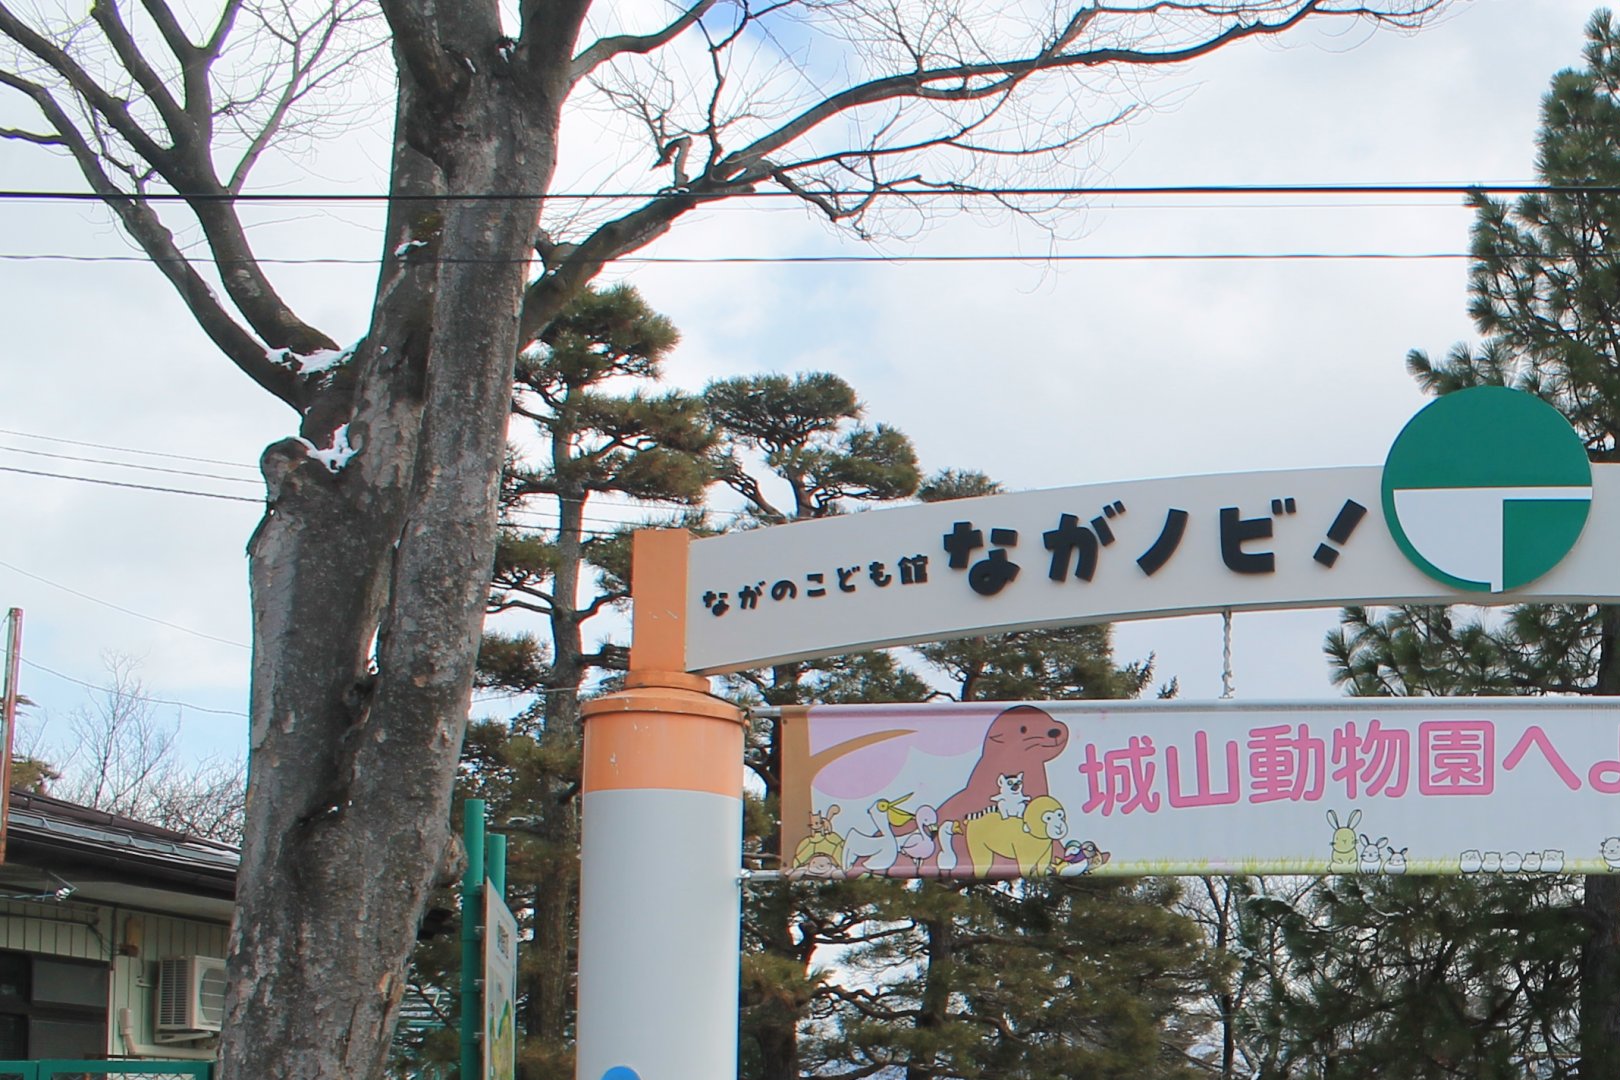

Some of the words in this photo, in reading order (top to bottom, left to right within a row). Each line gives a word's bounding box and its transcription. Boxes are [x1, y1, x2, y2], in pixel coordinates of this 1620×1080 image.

[702, 554, 929, 617] ながのこども館
